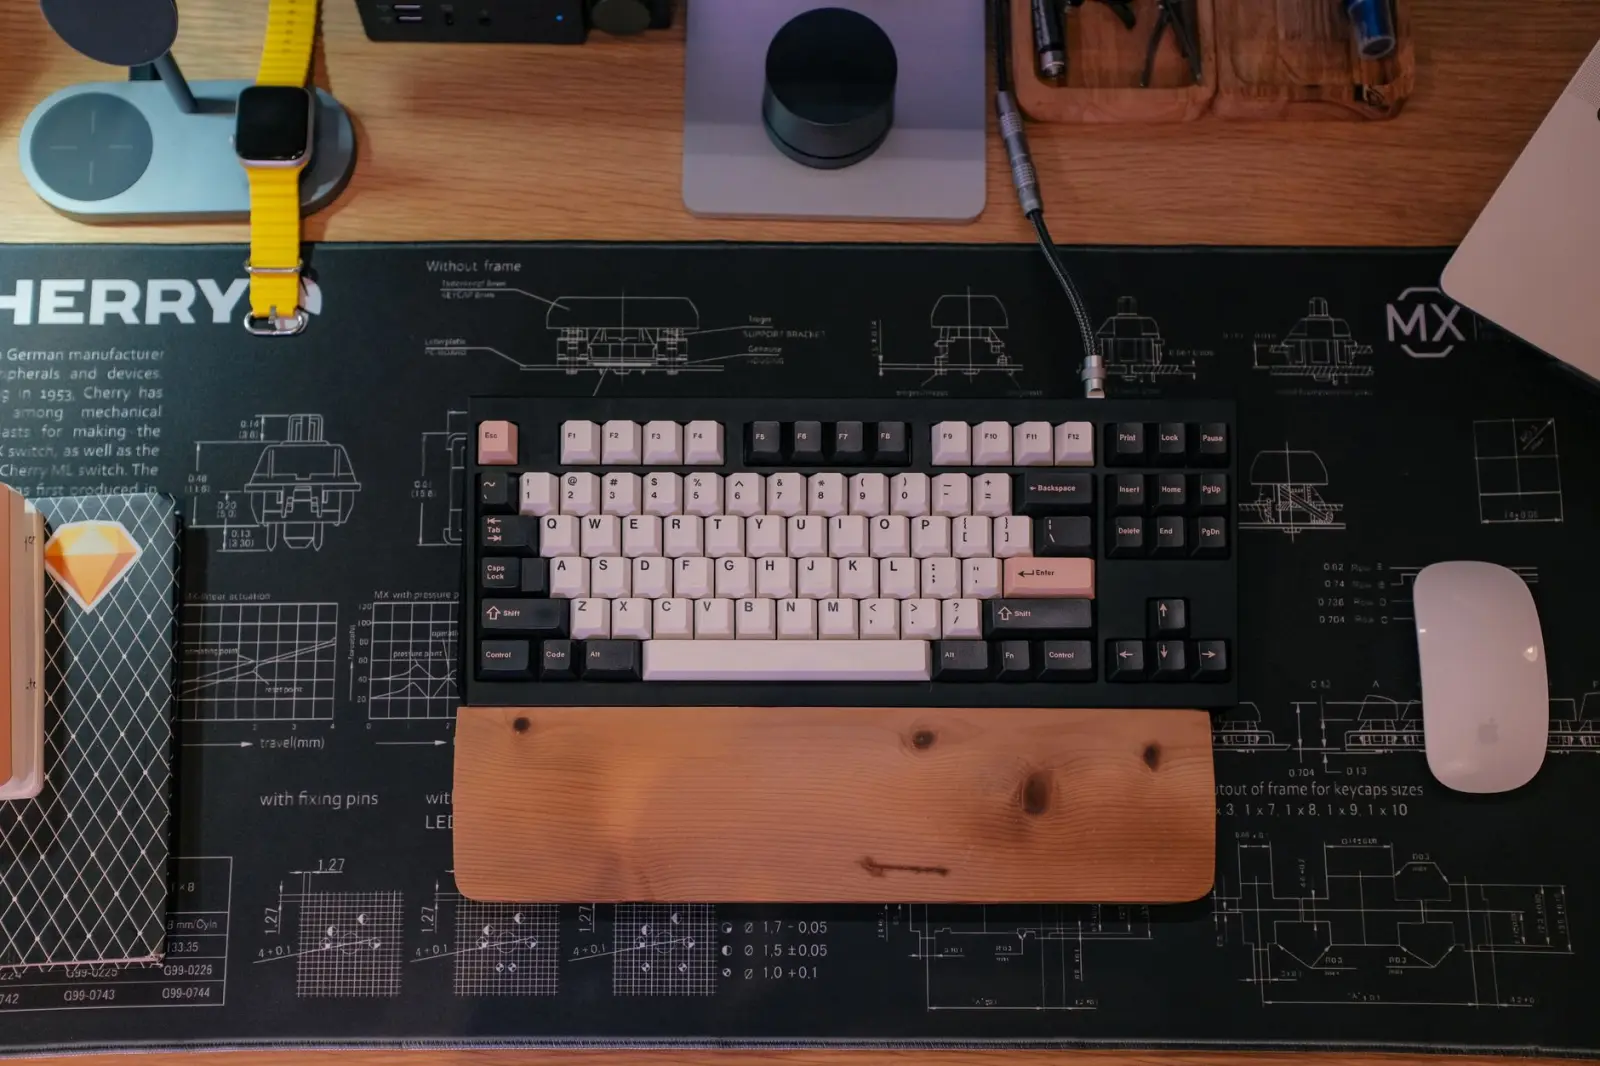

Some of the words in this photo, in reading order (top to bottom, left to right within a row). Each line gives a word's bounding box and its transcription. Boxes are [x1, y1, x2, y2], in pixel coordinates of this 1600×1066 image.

[426, 260, 478, 273] Without
[484, 260, 521, 272] frame
[1386, 303, 1466, 342] MX
[7, 348, 64, 361] German
[69, 347, 165, 360] manufacturer
[71, 367, 97, 380] and
[84, 386, 130, 402] Cherry
[139, 385, 164, 398] has
[13, 408, 64, 422] among
[82, 404, 163, 418] mechanical
[42, 423, 63, 437] for
[73, 424, 126, 440] making
[137, 424, 160, 437] the
[63, 447, 79, 457] as
[83, 444, 111, 457] well
[116, 446, 132, 457] as
[136, 444, 160, 457] the
[131, 464, 159, 477] The
[36, 482, 64, 496] first
[568, 491, 573, 499] 2
[610, 491, 615, 499] 3
[547, 518, 557, 529] Q
[589, 519, 601, 529] W
[630, 519, 638, 529] E
[672, 519, 680, 529] R
[714, 519, 721, 529] T
[756, 519, 763, 529] Y
[797, 519, 805, 530] U
[880, 519, 889, 529] O
[922, 520, 929, 529] P
[1202, 528, 1220, 536] PgDn
[557, 560, 566, 570] A
[599, 560, 607, 570] S
[641, 560, 649, 570] D
[683, 560, 689, 570] F
[724, 560, 734, 570] G
[766, 560, 774, 570] H
[807, 560, 814, 570] J
[849, 560, 857, 571] K
[890, 561, 897, 571] L
[374, 591, 389, 599] MX
[393, 591, 411, 599] with
[414, 592, 452, 600] pressure
[578, 601, 587, 611] Z
[620, 601, 627, 611] X
[662, 601, 671, 611] C
[703, 601, 711, 611] V
[745, 602, 753, 612] B
[787, 602, 795, 612] N
[828, 602, 838, 612] M
[260, 736, 325, 750] travel(mm)
[1251, 781, 1264, 796] of
[1268, 781, 1308, 796] frame
[1311, 781, 1330, 796] for
[1334, 781, 1388, 799] keycaps
[1391, 784, 1424, 796] sizes
[260, 793, 294, 806] with
[298, 791, 341, 809] fixing
[346, 792, 379, 809] pins
[1393, 803, 1408, 816] 10
[318, 858, 345, 870] 1.27
[264, 908, 278, 935] 1.27
[420, 906, 434, 933] 1.27
[579, 904, 592, 933] 1.27
